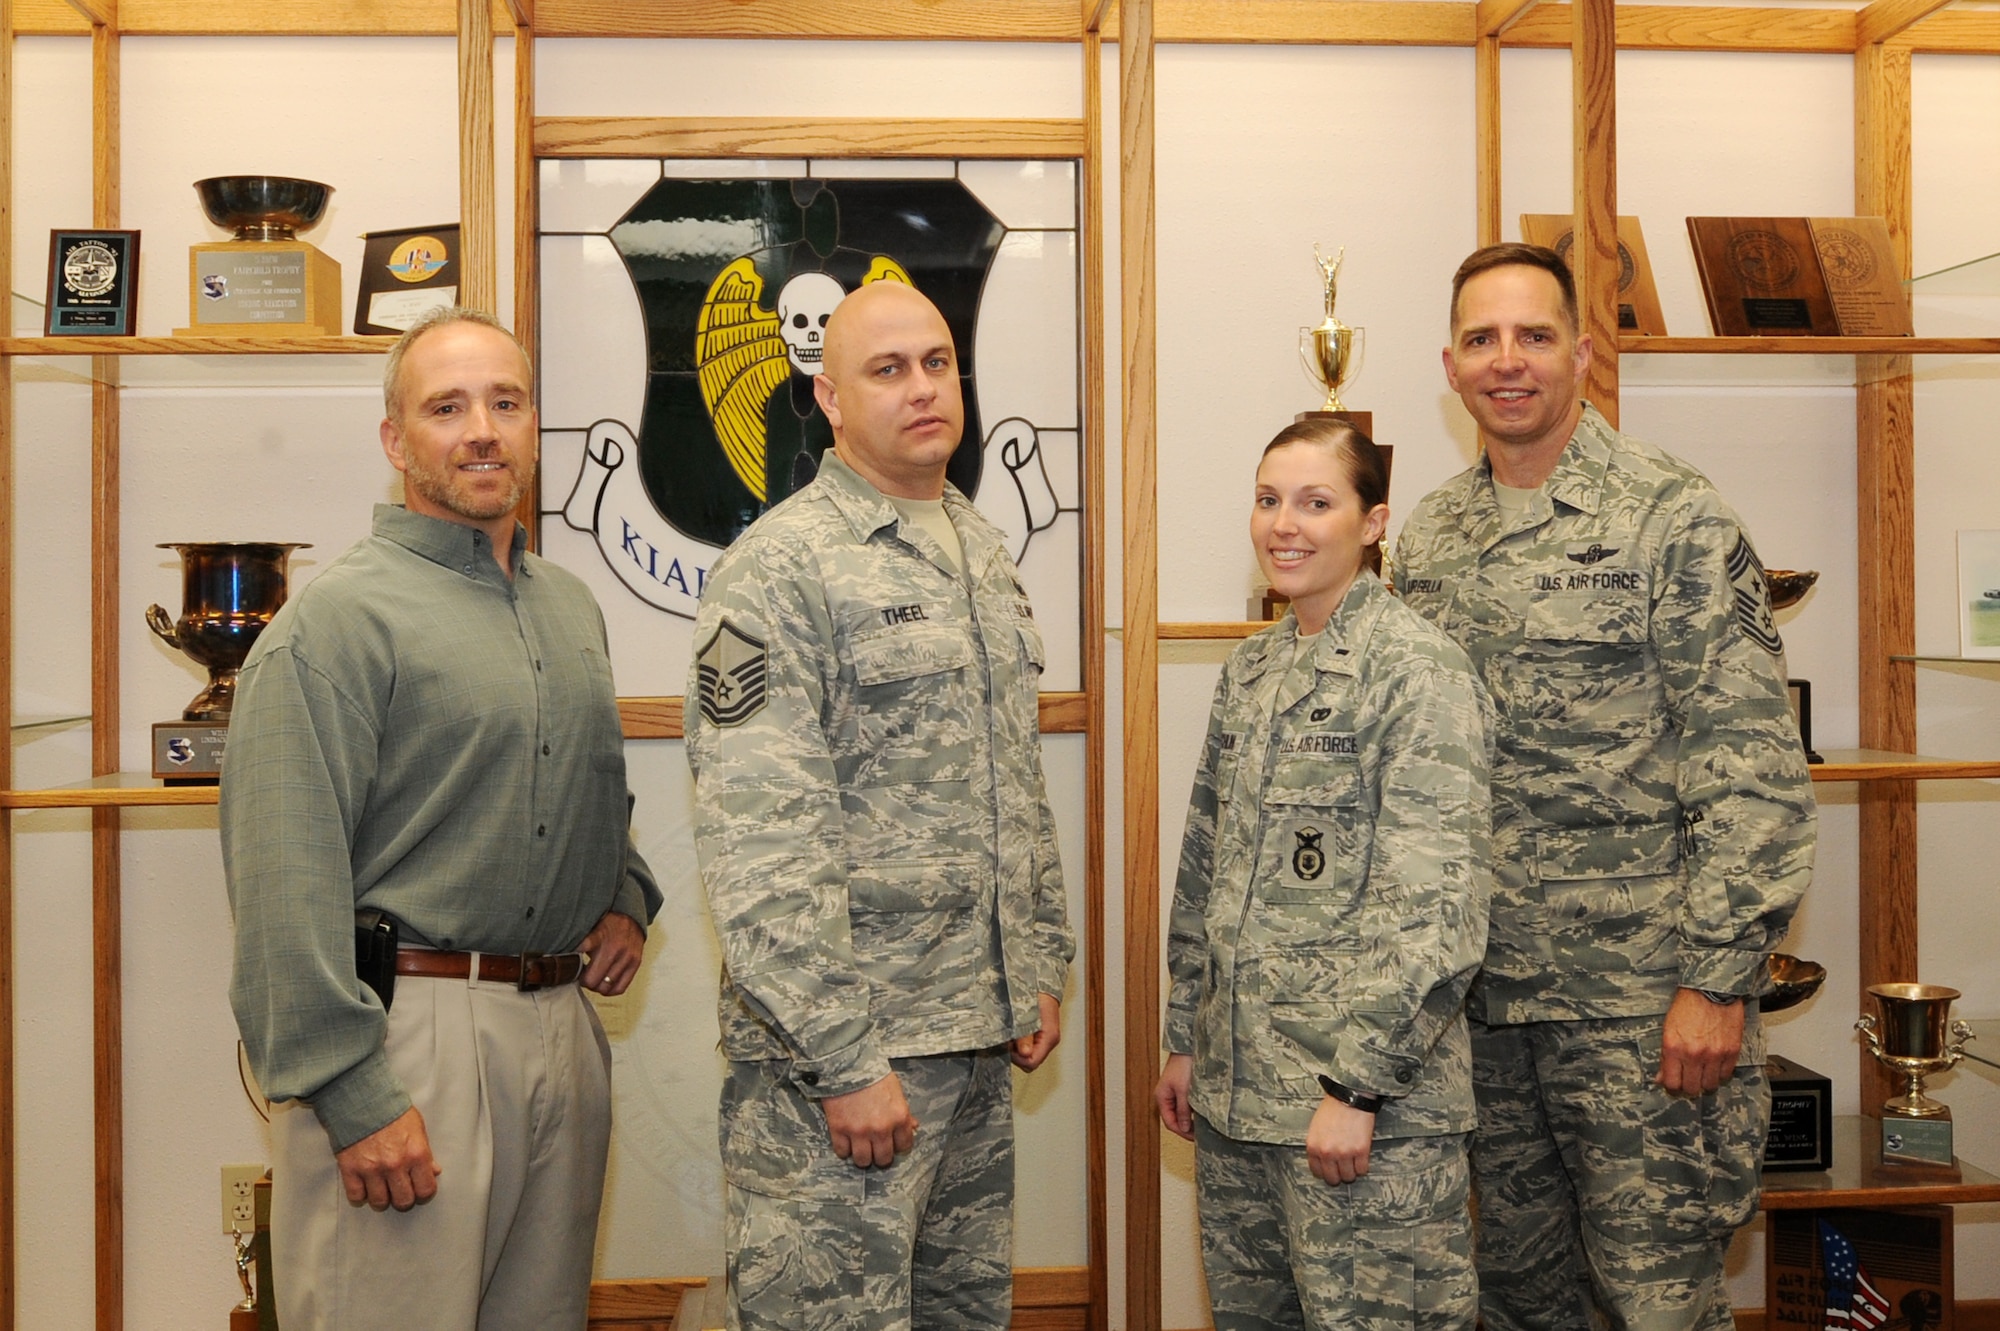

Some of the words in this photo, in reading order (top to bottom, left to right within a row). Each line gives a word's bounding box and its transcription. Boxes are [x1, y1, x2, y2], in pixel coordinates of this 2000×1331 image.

[79, 240, 108, 249] TATTOO
[272, 265, 301, 274] TROPHY
[1541, 576, 1563, 591] U.S.
[1566, 574, 1588, 590] AIR
[1592, 573, 1640, 590] FORCE
[881, 605, 929, 626] THEEL
[1296, 736, 1314, 753] AIR
[1314, 735, 1359, 754] FORCE
[1777, 1100, 1812, 1109] TROPHY
[1777, 1273, 1804, 1290] AIR
